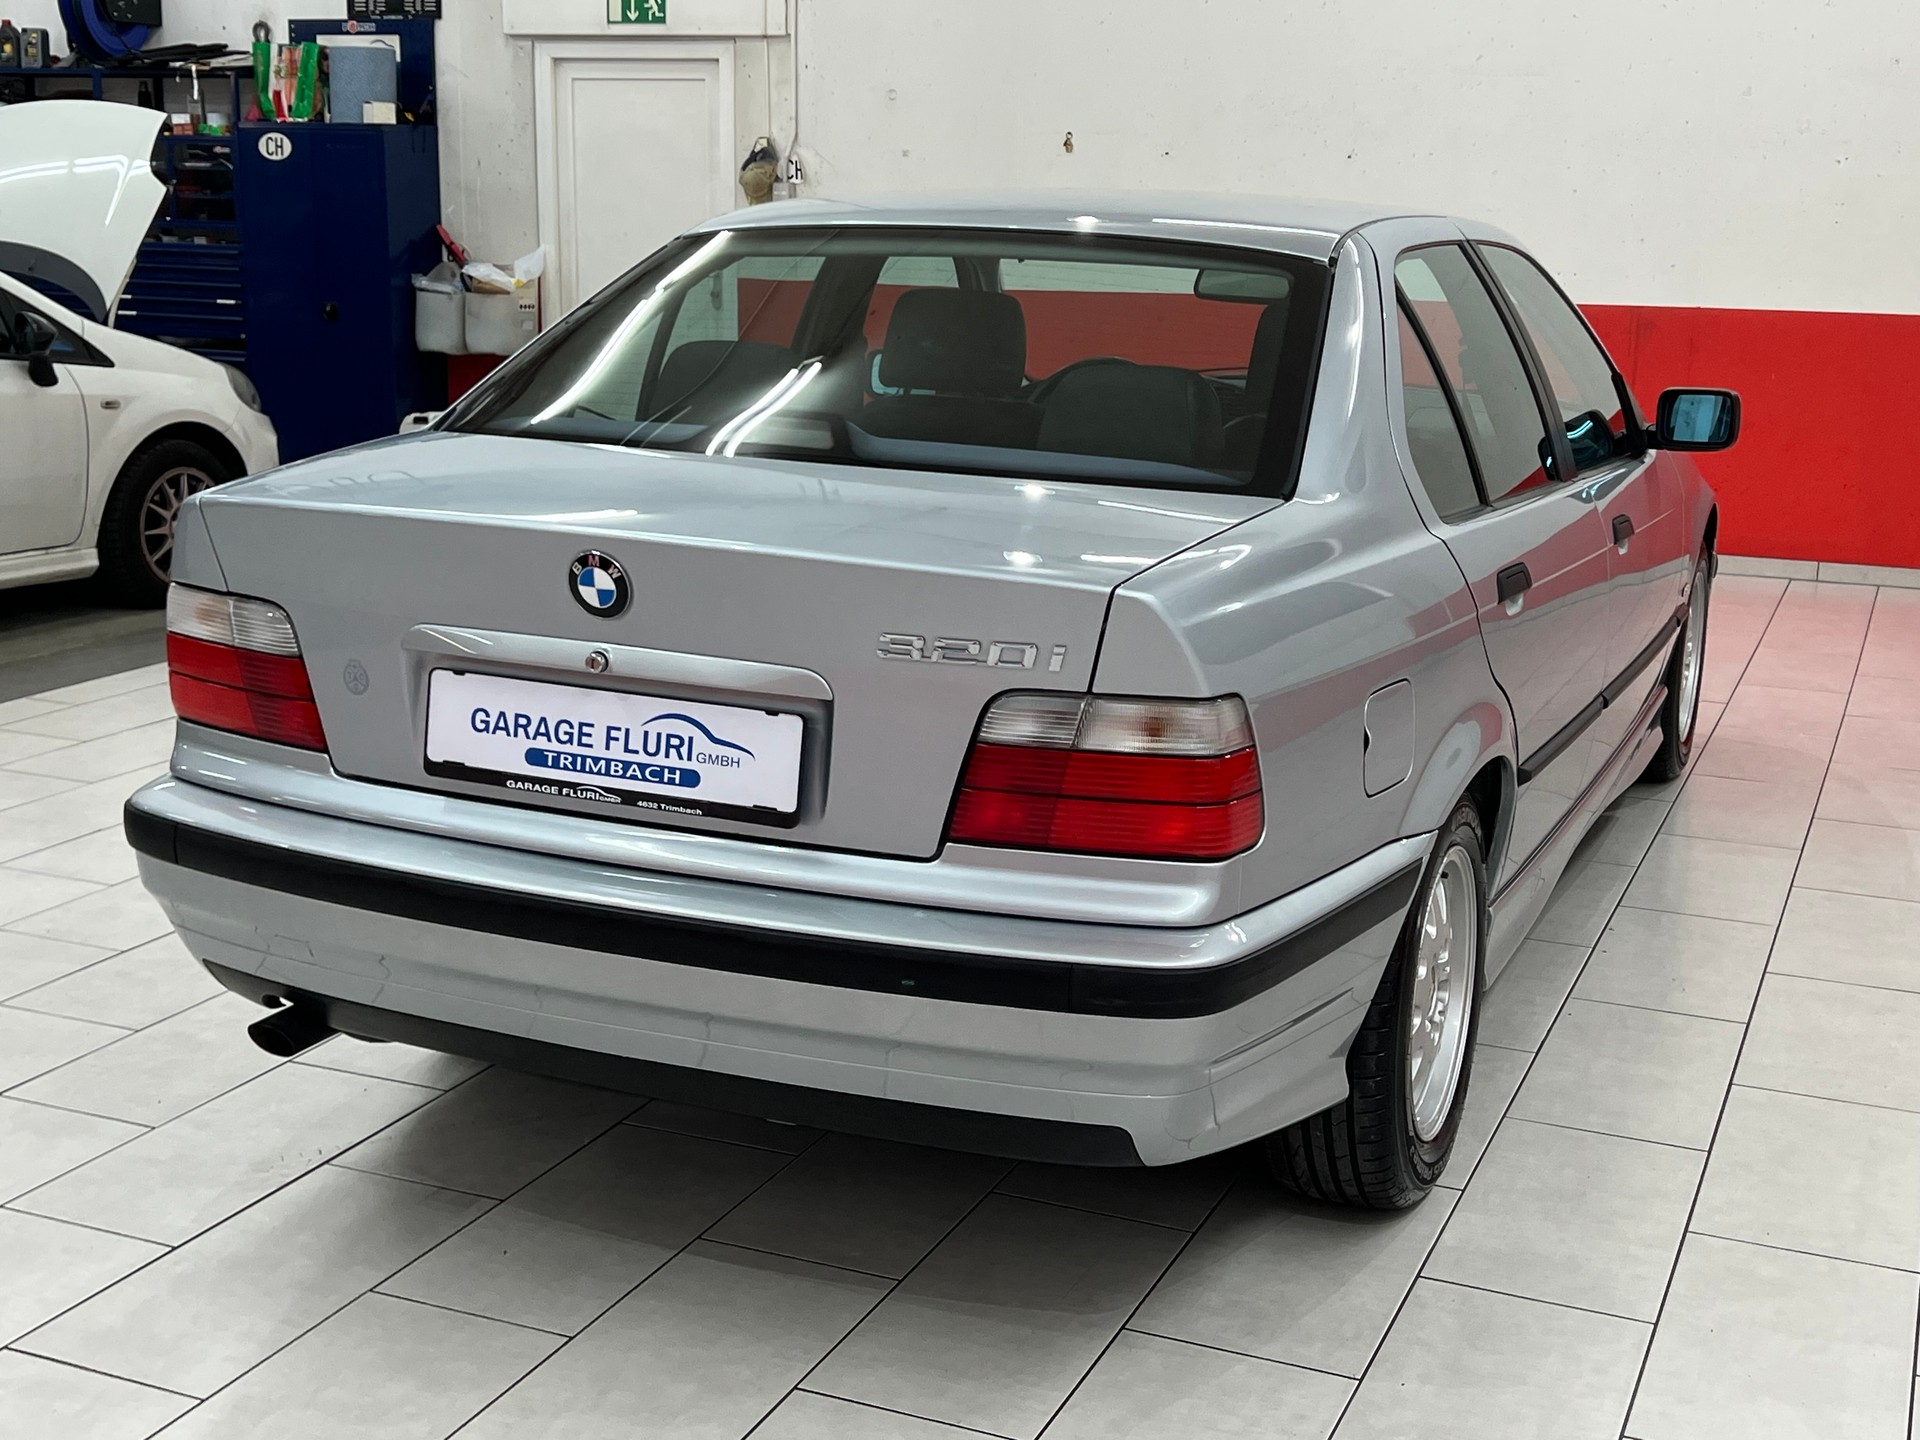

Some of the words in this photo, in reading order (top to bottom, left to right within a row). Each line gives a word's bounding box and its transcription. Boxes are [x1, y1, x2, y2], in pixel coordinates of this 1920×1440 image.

[266, 136, 284, 156] CH
[572, 555, 622, 579] BMW
[877, 632, 1067, 672] 320i
[470, 707, 595, 749] GARAGE
[604, 725, 694, 762] FLURI
[696, 752, 741, 769] GMBH
[543, 750, 681, 785] TRIMBACH
[506, 780, 559, 795] GARAGE
[562, 788, 599, 801] FLURI
[637, 801, 658, 810] 4632
[660, 803, 703, 815] Trimbach
